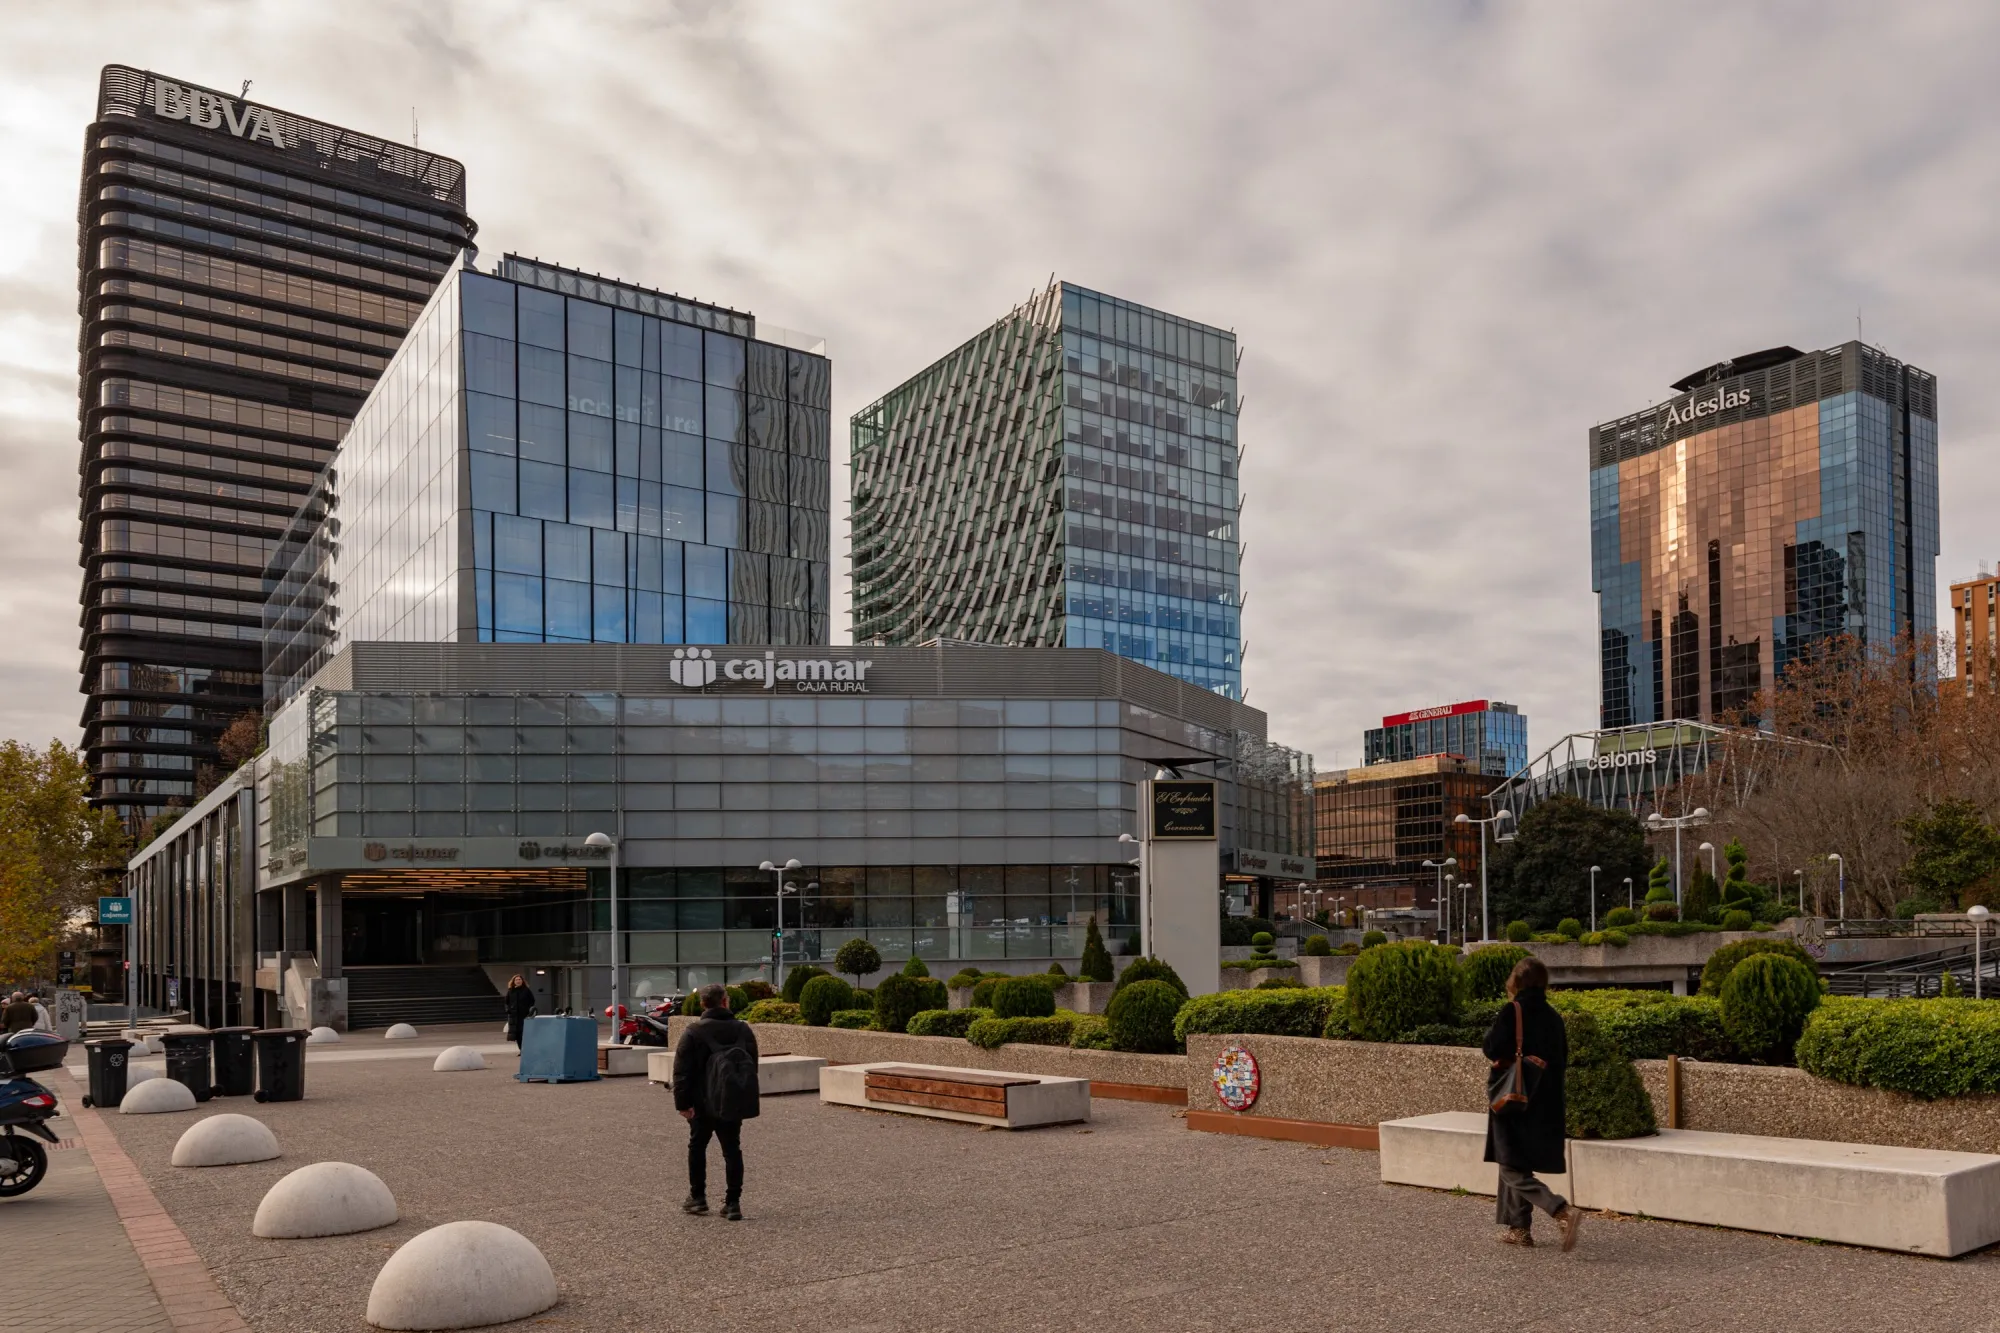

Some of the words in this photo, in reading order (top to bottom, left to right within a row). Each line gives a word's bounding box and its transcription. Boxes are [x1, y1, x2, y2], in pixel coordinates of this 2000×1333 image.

[154, 79, 286, 149] BBVA
[1663, 386, 1751, 432] Adeslas
[724, 651, 873, 689] cajamar
[797, 681, 827, 692] CAJA
[830, 681, 870, 692] RURAL
[1418, 706, 1453, 719] GENERALI
[1586, 746, 1657, 771] celonis
[1155, 791, 1170, 804] El
[1169, 791, 1212, 806] Enfriador
[390, 844, 460, 863] cajamar
